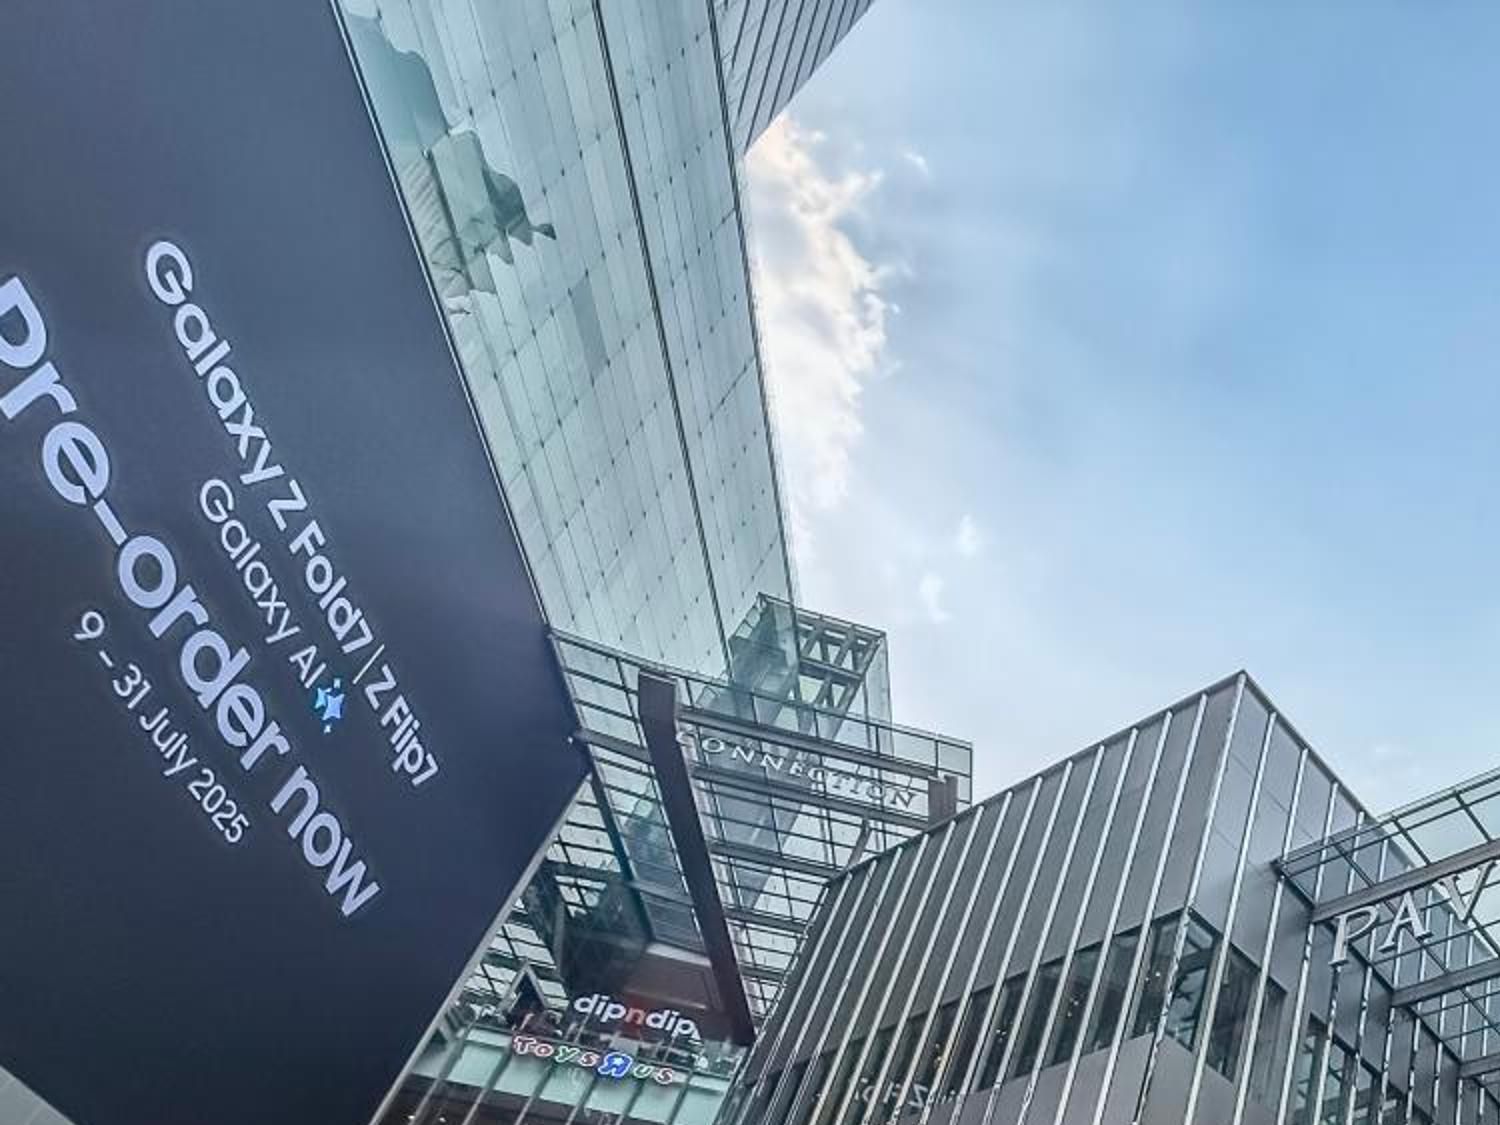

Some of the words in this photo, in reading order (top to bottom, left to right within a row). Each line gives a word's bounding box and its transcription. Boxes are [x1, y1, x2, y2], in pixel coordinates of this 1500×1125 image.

[145, 241, 285, 485] Galaxy
[199, 478, 301, 644] Galaxy
[289, 645, 328, 689] AI
[267, 479, 308, 532] Z
[288, 519, 375, 655] Fold7
[0, 276, 291, 771] Pre-order
[270, 765, 380, 916] now
[74, 611, 105, 640] 9
[112, 663, 153, 710] 31
[139, 707, 198, 778] July
[187, 768, 249, 843] 2025
[364, 664, 398, 710] Z
[380, 694, 439, 786] Flip7
